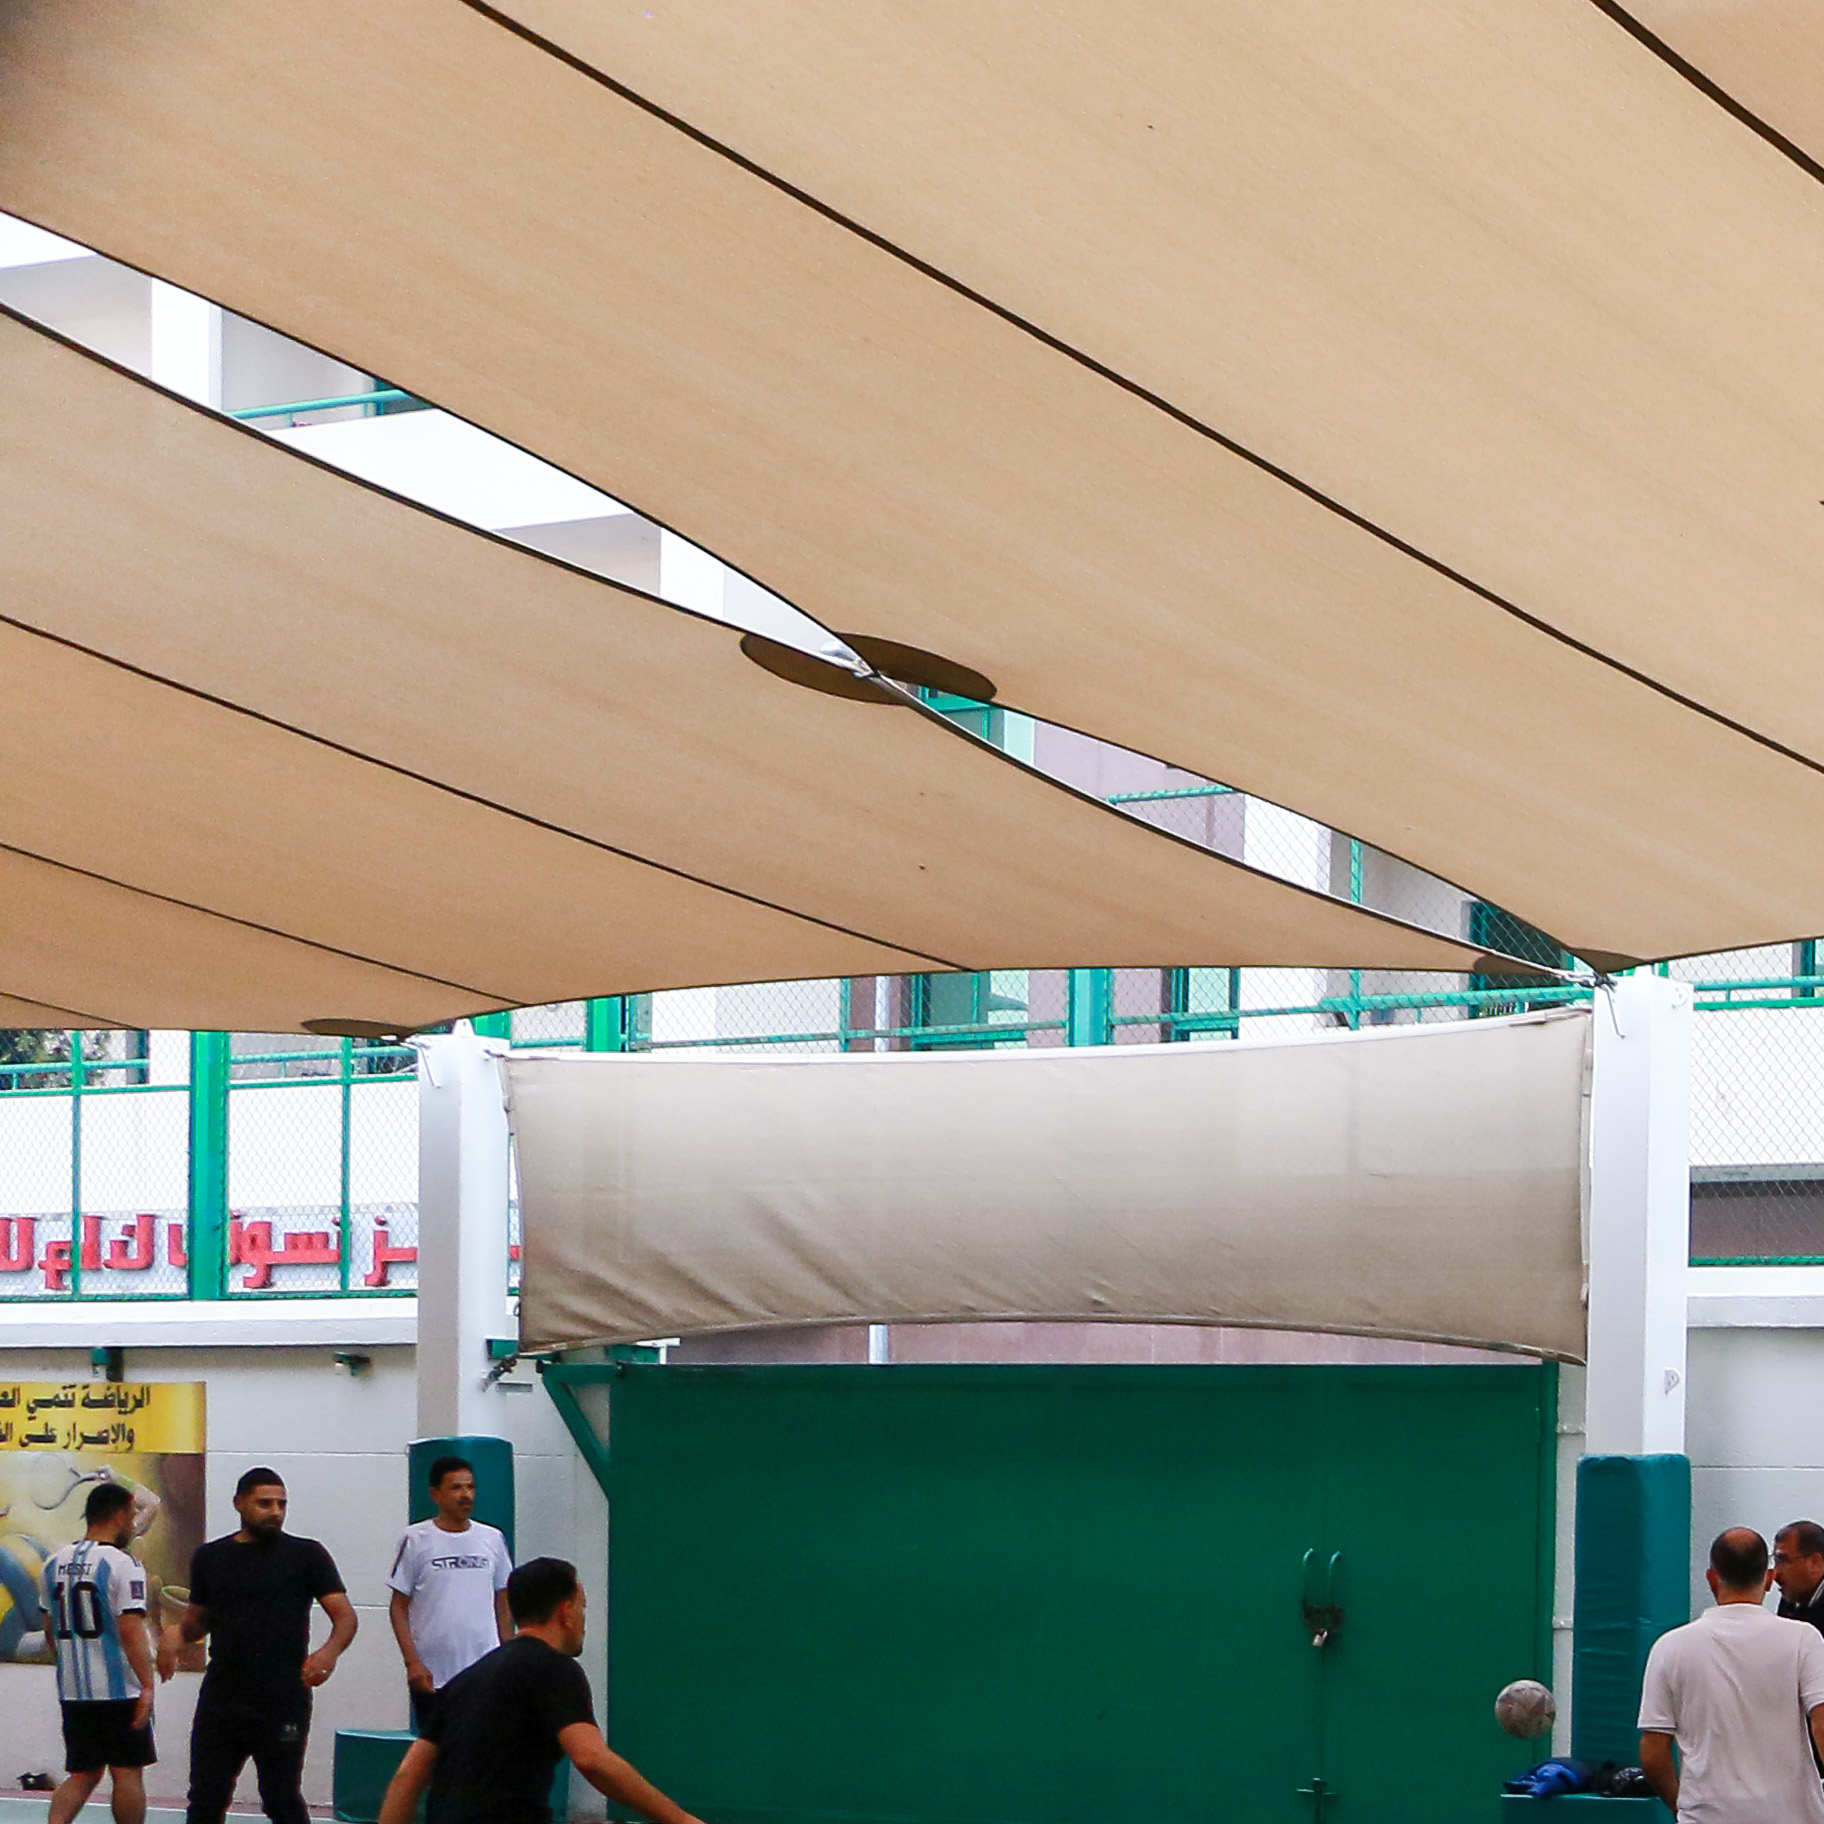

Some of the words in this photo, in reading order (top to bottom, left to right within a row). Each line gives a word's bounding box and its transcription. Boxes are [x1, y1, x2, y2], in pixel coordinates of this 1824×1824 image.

[81, 1384, 150, 1415] الرياضة
[19, 1421, 58, 1448] على
[52, 1581, 104, 1639] 10
